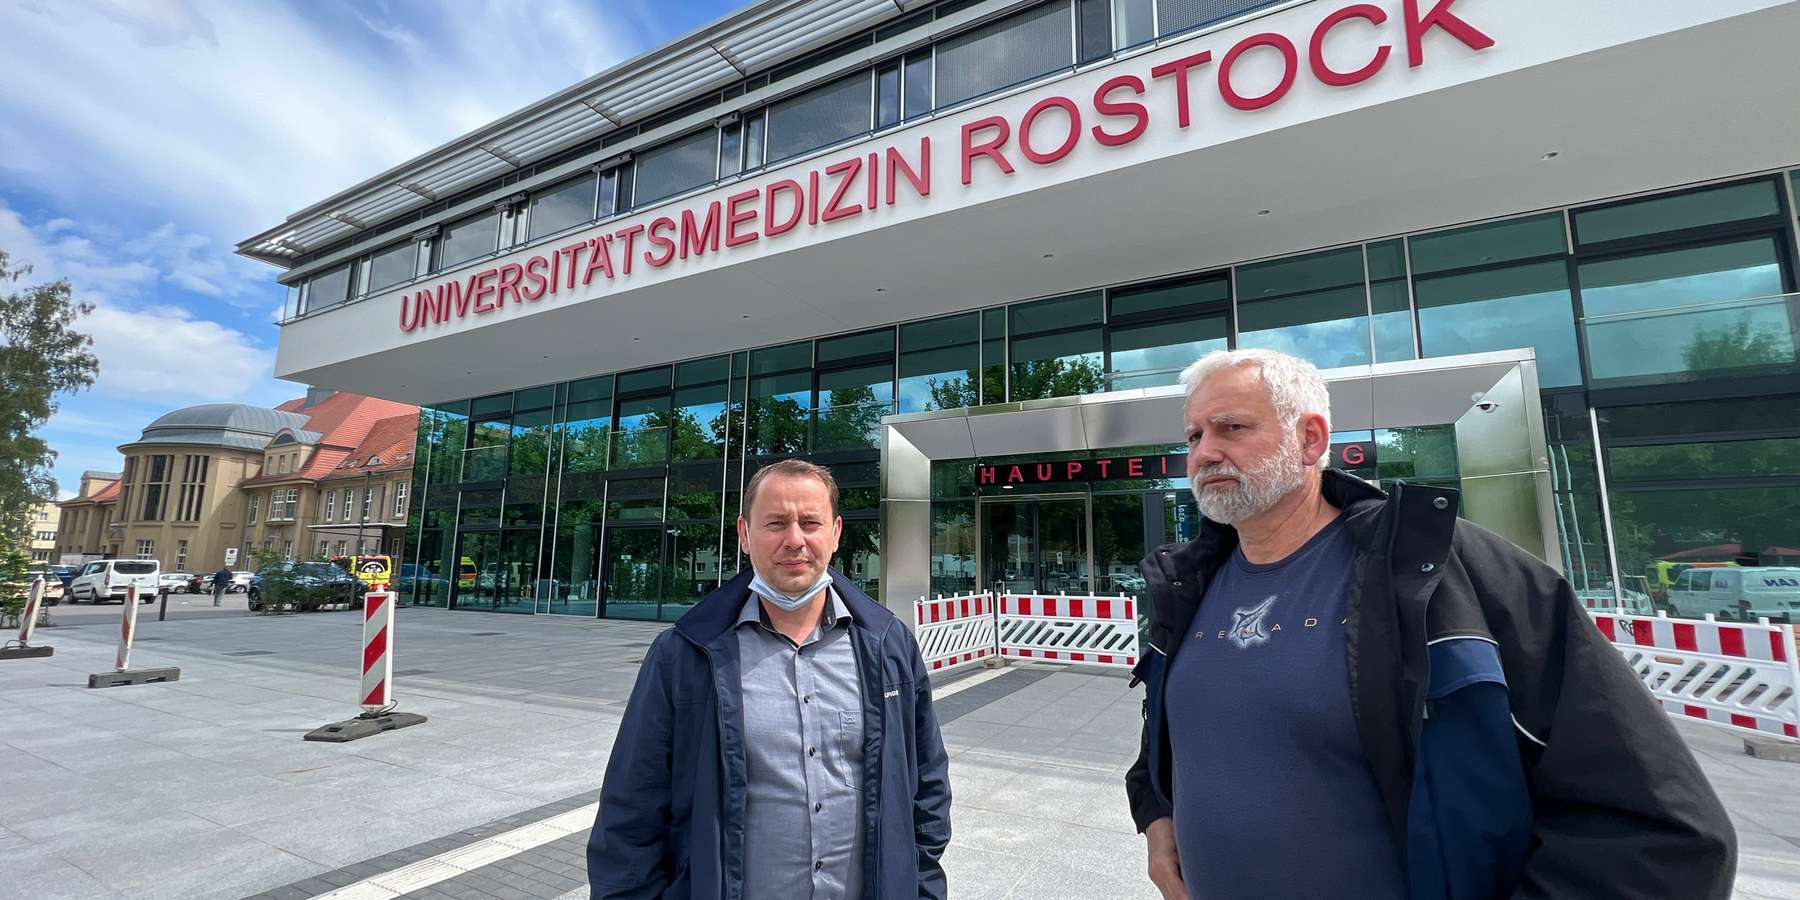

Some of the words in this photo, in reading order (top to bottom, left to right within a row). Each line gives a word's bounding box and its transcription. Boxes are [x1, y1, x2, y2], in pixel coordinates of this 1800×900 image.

[399, 137, 931, 332] UNIVERSITÄTSMEDIZIN
[961, 0, 1495, 185] ROSTOCK
[980, 444, 1366, 484] HAUPTEIG
